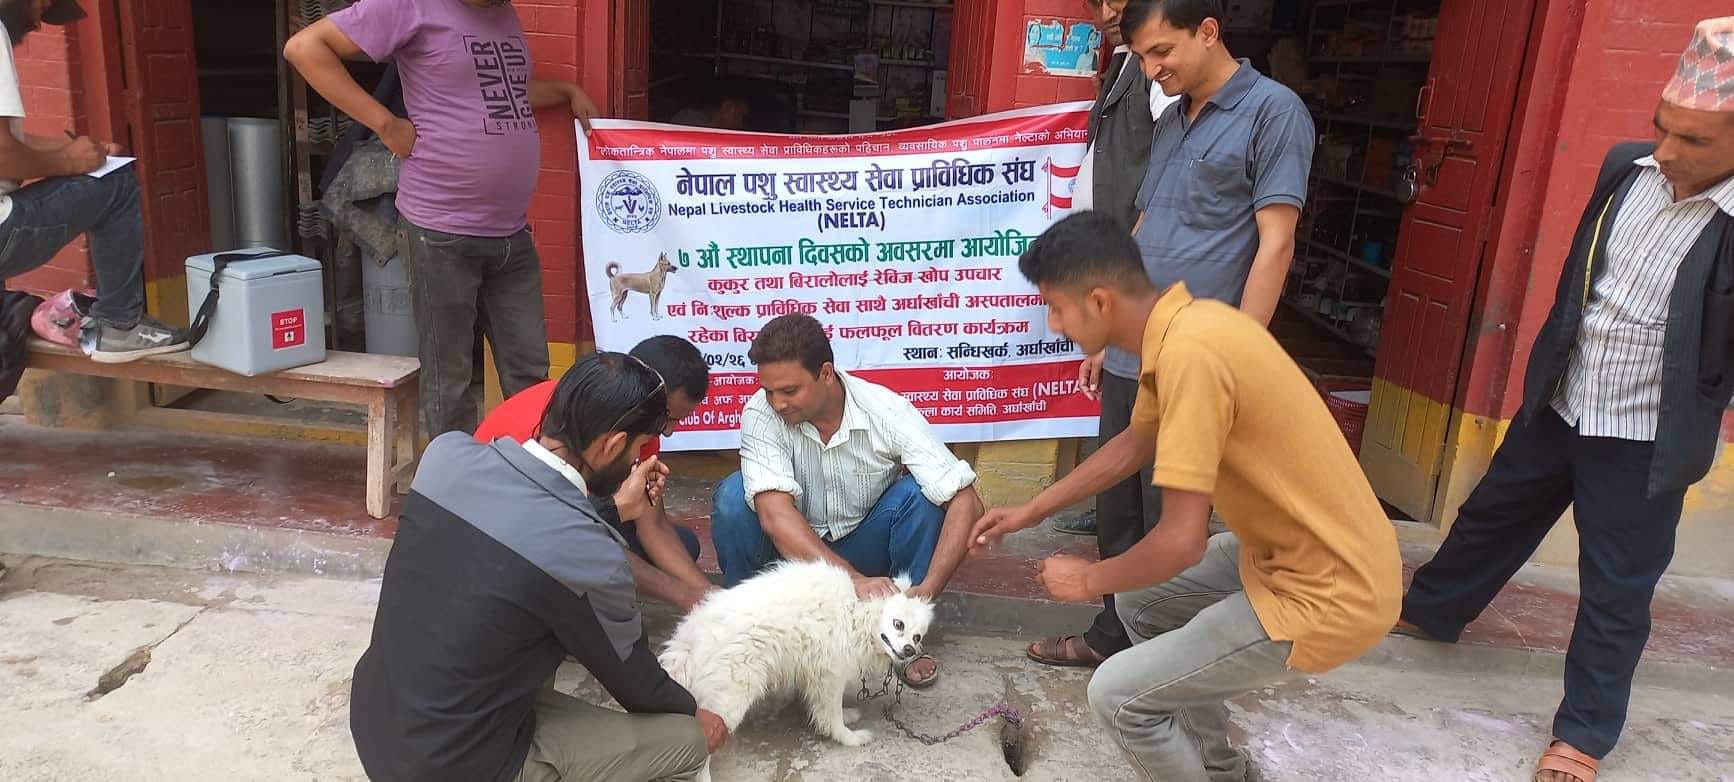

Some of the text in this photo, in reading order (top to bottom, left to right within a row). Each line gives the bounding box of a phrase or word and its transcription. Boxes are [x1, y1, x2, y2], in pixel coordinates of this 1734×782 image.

[500, 42, 526, 67] UP
[471, 41, 514, 119] NEVER
[660, 145, 697, 156] नेपालमा
[722, 146, 756, 156] स्वास्थ्य
[760, 145, 778, 155] सेवा
[973, 136, 1009, 147] पालनमा
[1014, 131, 1050, 144] नेल्टाको
[675, 157, 1036, 200] नेपाल पशु स्वास्थ्य सेवा प्राविधिक संघ
[669, 190, 1035, 218] Nepal Livestock Health Service Technician Association
[817, 213, 885, 231] (NELTA)
[678, 248, 690, 268] ७
[726, 244, 793, 268] स्थापना
[799, 238, 870, 264] दिवसको
[876, 240, 955, 262] अवसरमा
[708, 278, 749, 295] कुकुर
[755, 276, 783, 290] तथा
[789, 272, 869, 287] बिरालोलाई
[919, 267, 950, 282] खोप
[954, 267, 1003, 281] उपचार
[667, 301, 686, 317] एवं
[757, 300, 817, 319] प्राविधिक
[822, 298, 850, 312] सेवा
[855, 295, 886, 312] साथै
[280, 317, 297, 325] STOP
[688, 328, 728, 344] रहेका
[839, 324, 903, 340] फलफूल
[908, 320, 958, 337] वितरण
[963, 319, 1029, 335] कार्यक्रम
[943, 390, 962, 401] सेवा
[966, 388, 1008, 401] प्राविधिक
[1012, 387, 1028, 398] संघ
[703, 410, 715, 425] Of
